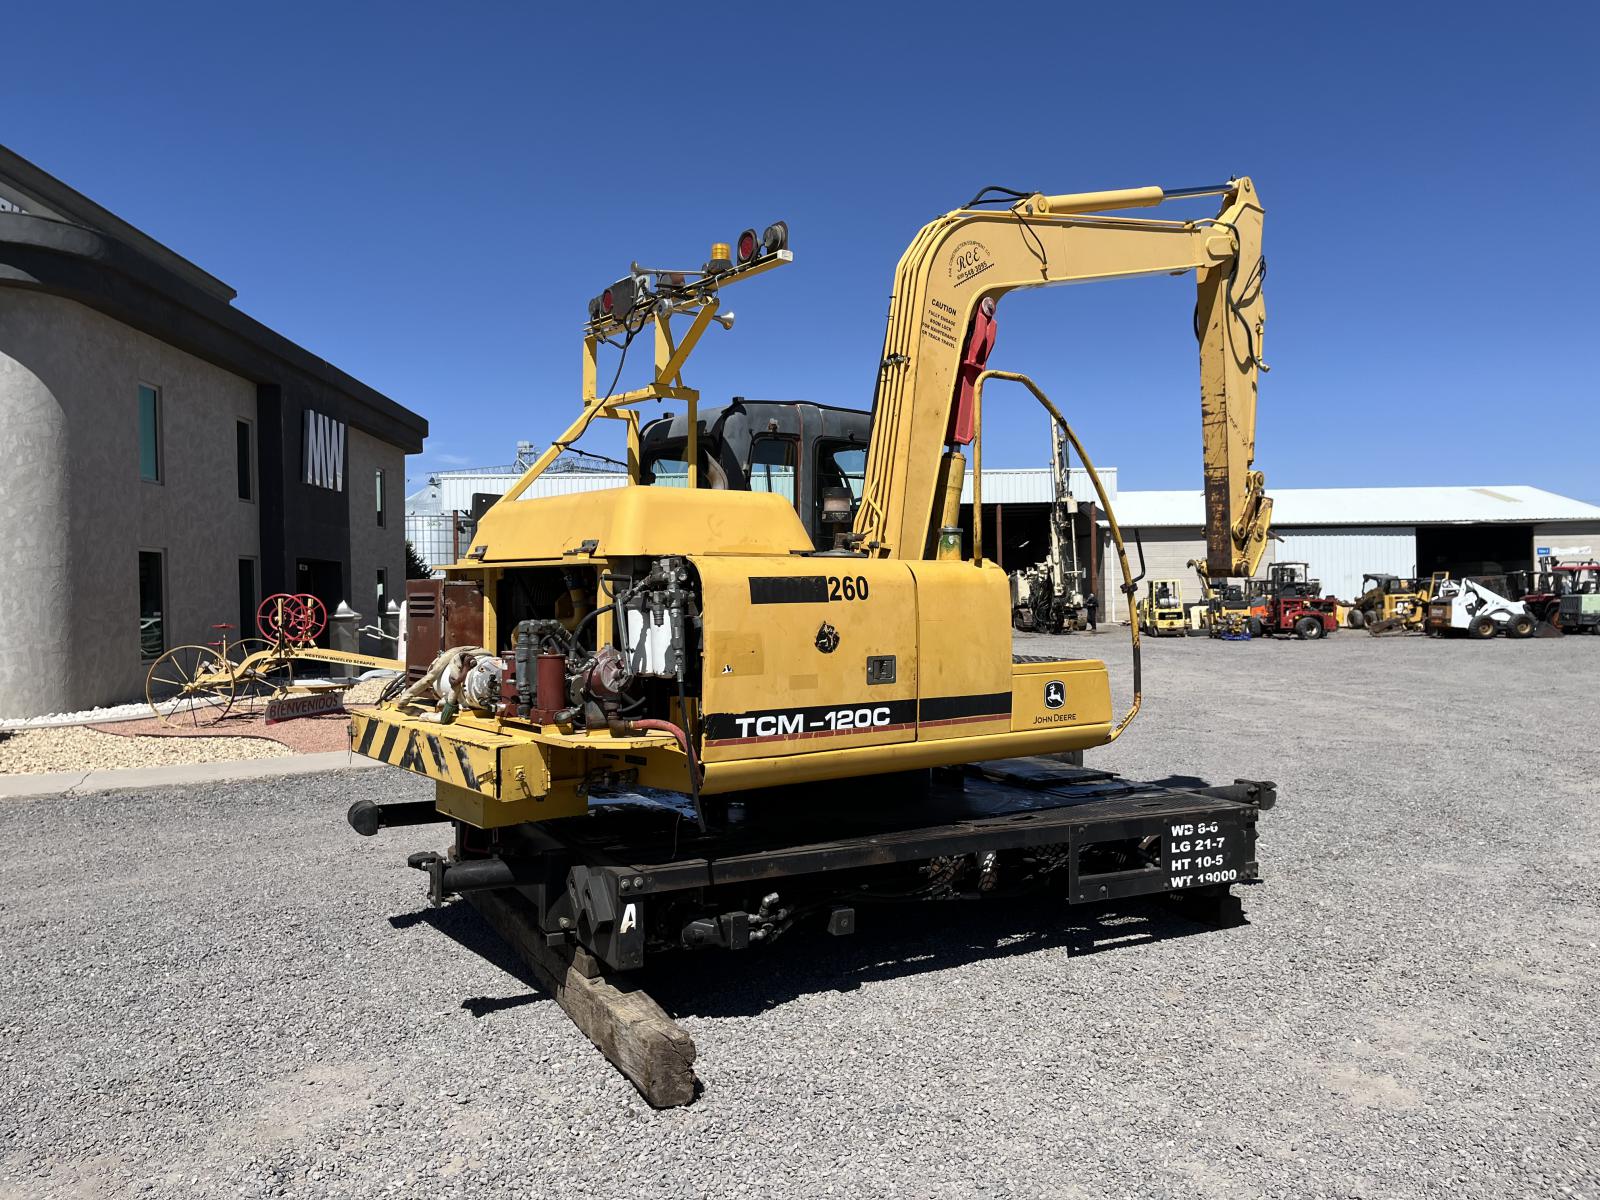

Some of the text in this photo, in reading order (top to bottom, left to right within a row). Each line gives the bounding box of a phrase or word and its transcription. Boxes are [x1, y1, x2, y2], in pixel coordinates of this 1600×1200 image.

[957, 246, 981, 273] RCE
[931, 298, 957, 316] CAUTION
[928, 309, 956, 326] FULLY ENGAGE
[929, 318, 952, 332] BOOM LOCK
[921, 321, 957, 342] FOR MAINTENANCE
[928, 331, 941, 342] TRACK
[940, 338, 955, 349] TRAVEL
[306, 409, 345, 492] MW
[828, 576, 869, 601] 260
[269, 697, 338, 718] BIENVENIDOS
[1171, 824, 1194, 837] WD
[1171, 836, 1226, 853] LG 21-7
[1171, 854, 1223, 871] HT 10-5
[1170, 869, 1237, 888] WT 19000
[619, 903, 637, 934] A
